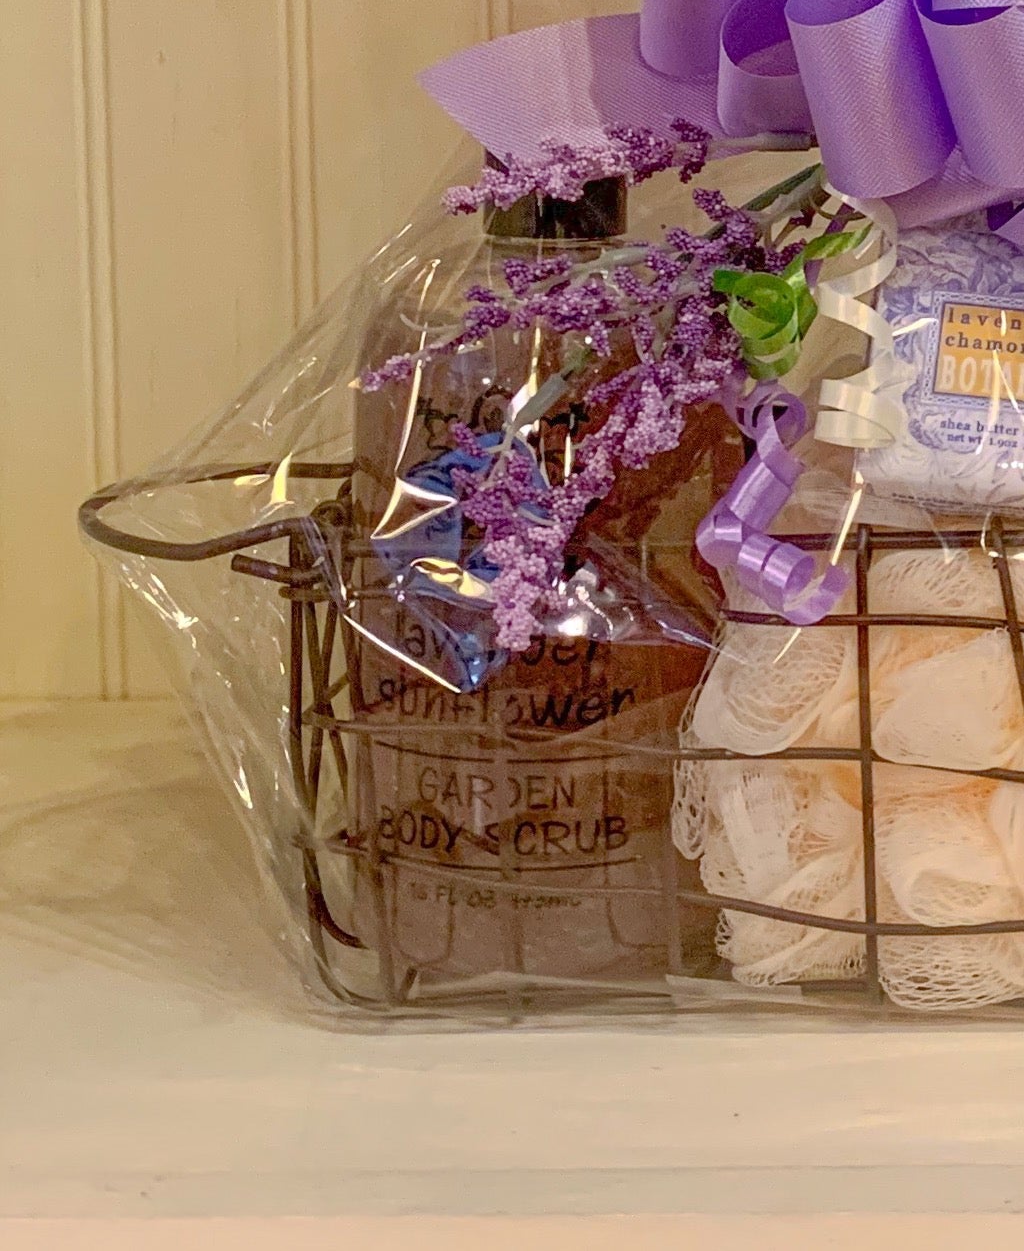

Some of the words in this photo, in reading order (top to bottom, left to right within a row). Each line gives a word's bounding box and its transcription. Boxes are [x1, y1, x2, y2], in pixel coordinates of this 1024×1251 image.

[939, 418, 971, 433] shea
[976, 419, 1020, 438] btter
[946, 433, 966, 444] net
[378, 677, 636, 728] sunflower
[378, 804, 464, 850] BODY
[483, 814, 630, 857] SCRUB
